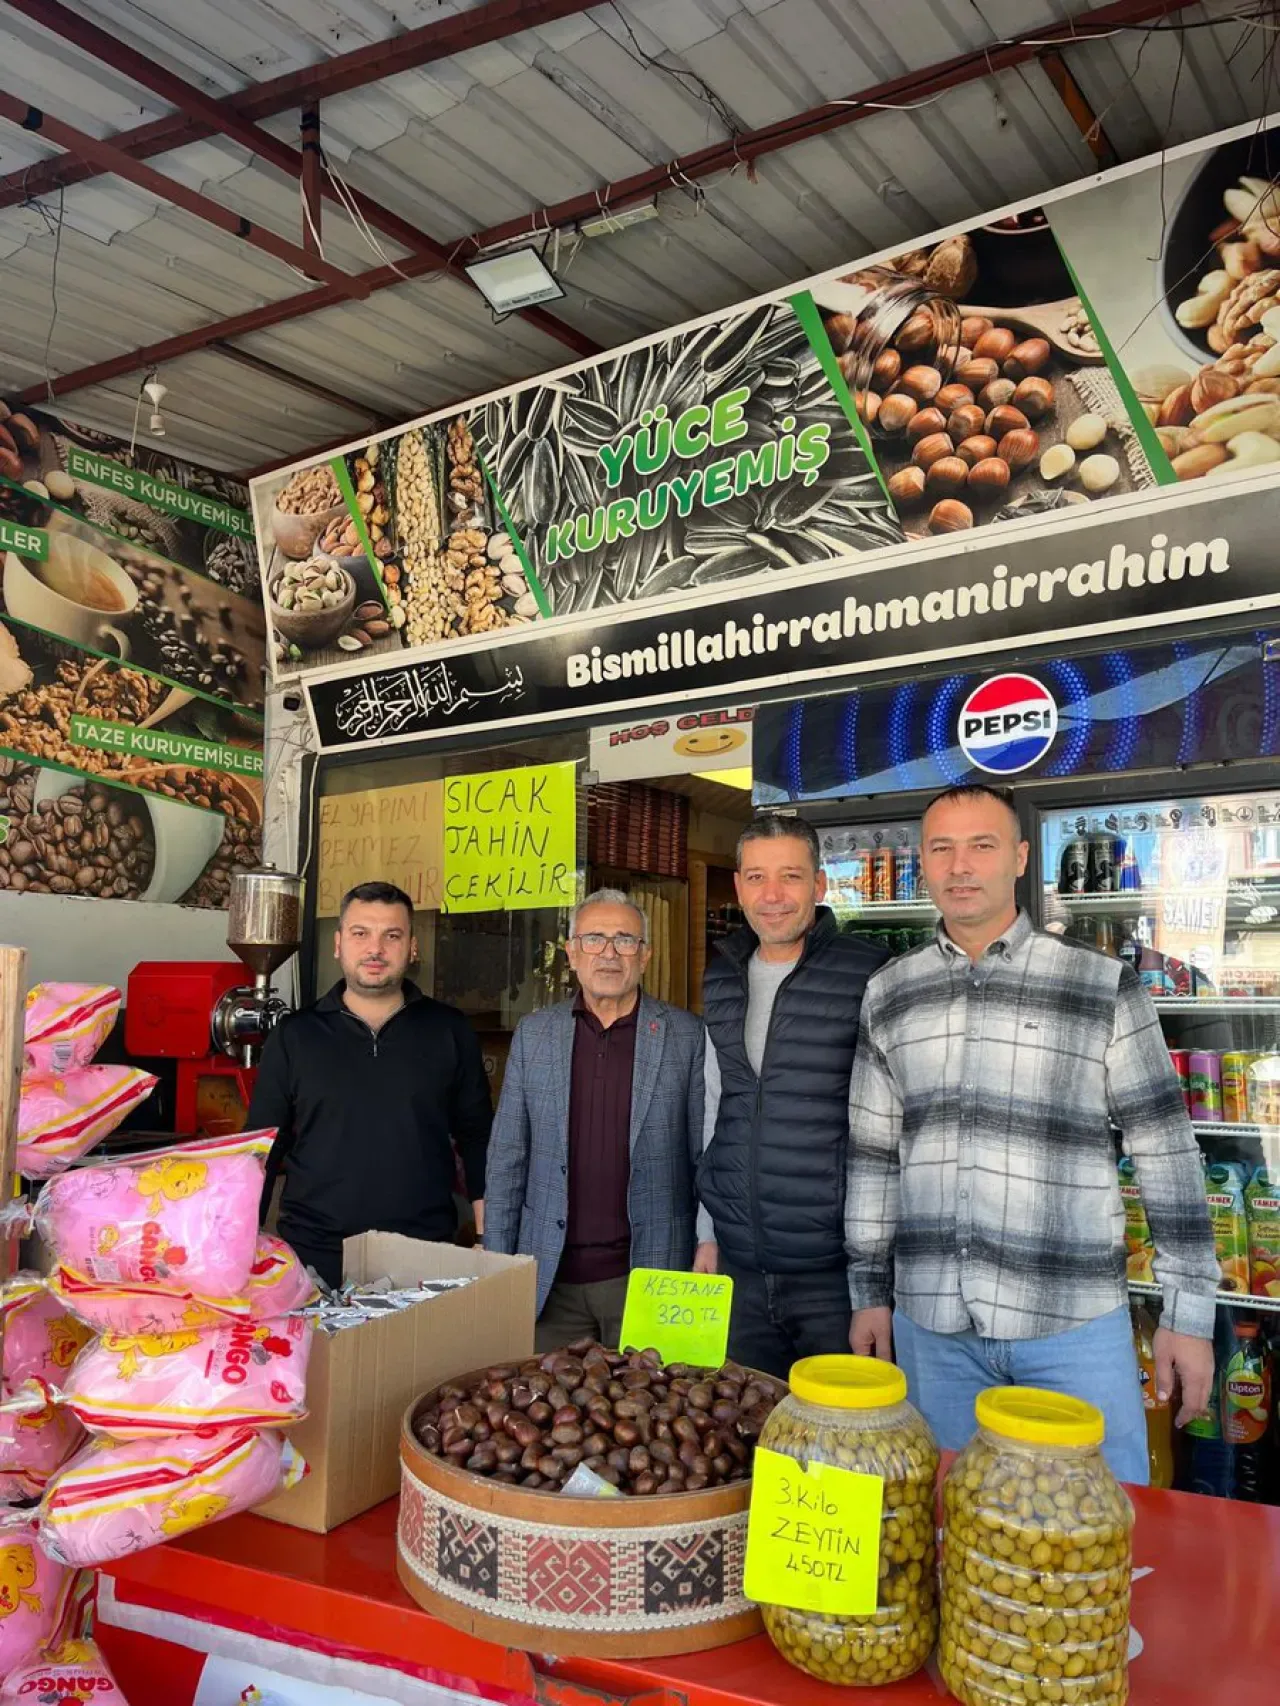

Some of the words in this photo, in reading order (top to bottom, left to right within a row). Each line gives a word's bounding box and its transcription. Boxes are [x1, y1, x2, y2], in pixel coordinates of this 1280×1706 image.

[599, 386, 750, 488] YÜCE
[73, 454, 135, 491] ENFES
[546, 416, 831, 564] KURUYEMİŞ
[567, 533, 1229, 688] Bismillahirrahmanirrahim
[964, 709, 1051, 738] PEPSI
[75, 721, 125, 745] TAZE
[131, 733, 264, 772] KURUYEMİŞLER
[446, 775, 551, 813] SICAK
[446, 862, 570, 899] ÇEKİLİR
[643, 1275, 726, 1297] KESTANE
[656, 1304, 694, 1326] 320
[700, 1307, 721, 1321] TL
[771, 1516, 860, 1556] ZEYTİN
